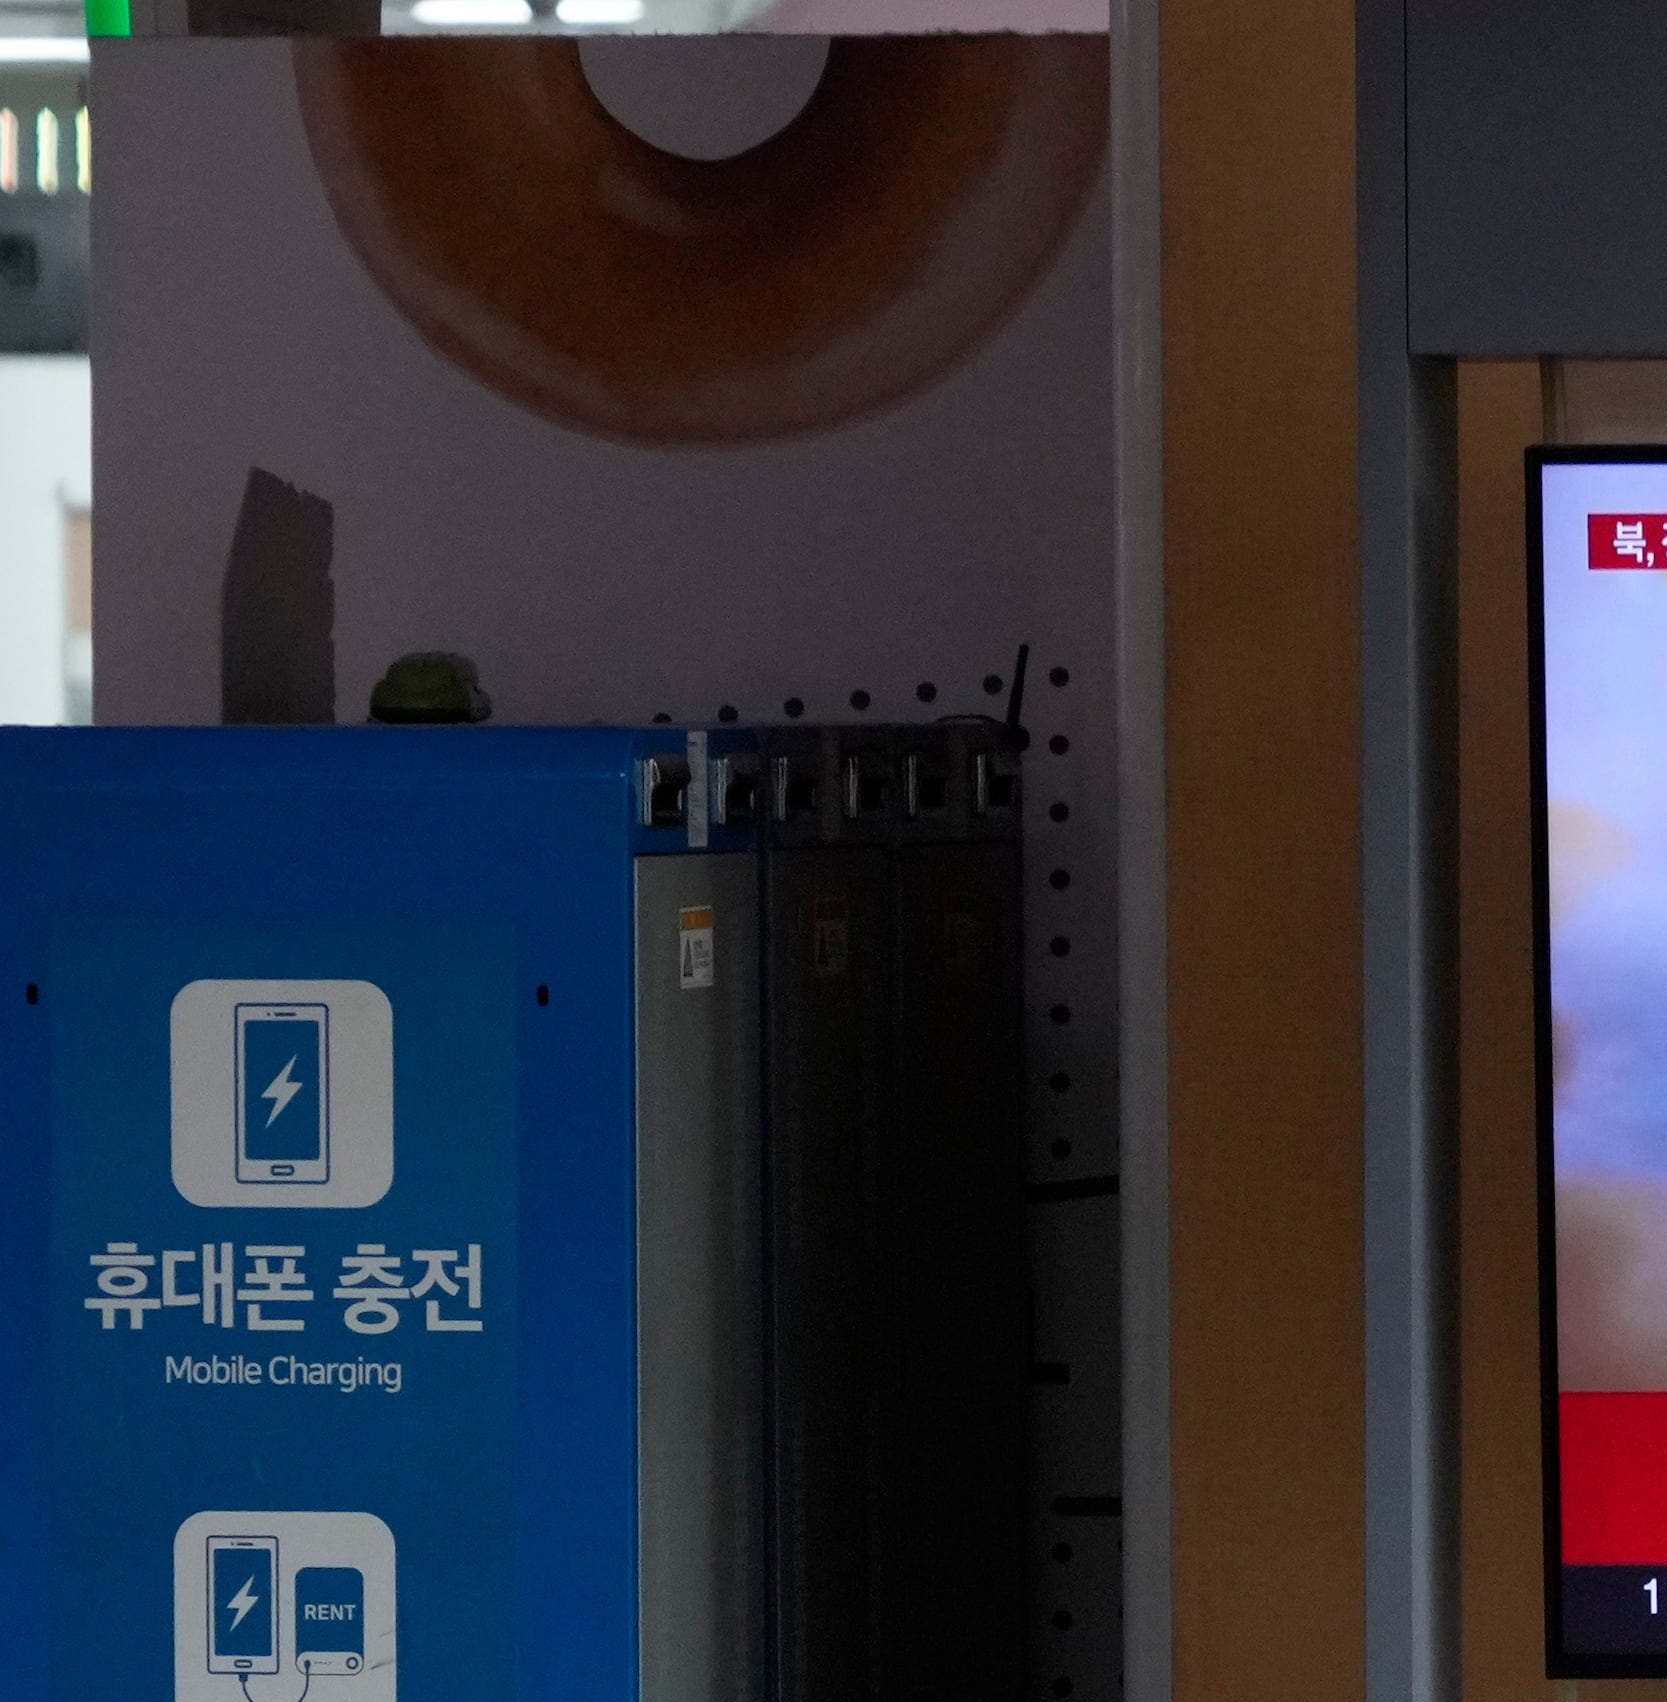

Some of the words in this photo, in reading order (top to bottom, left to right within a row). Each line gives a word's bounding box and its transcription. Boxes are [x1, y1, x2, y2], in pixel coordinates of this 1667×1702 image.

[1613, 520, 1655, 567] 북,
[84, 1242, 314, 1332] 휴대폰
[333, 1243, 483, 1334] 충전
[165, 1356, 262, 1386] Mobile
[269, 1356, 402, 1393] Charging
[304, 1604, 356, 1620] RENT
